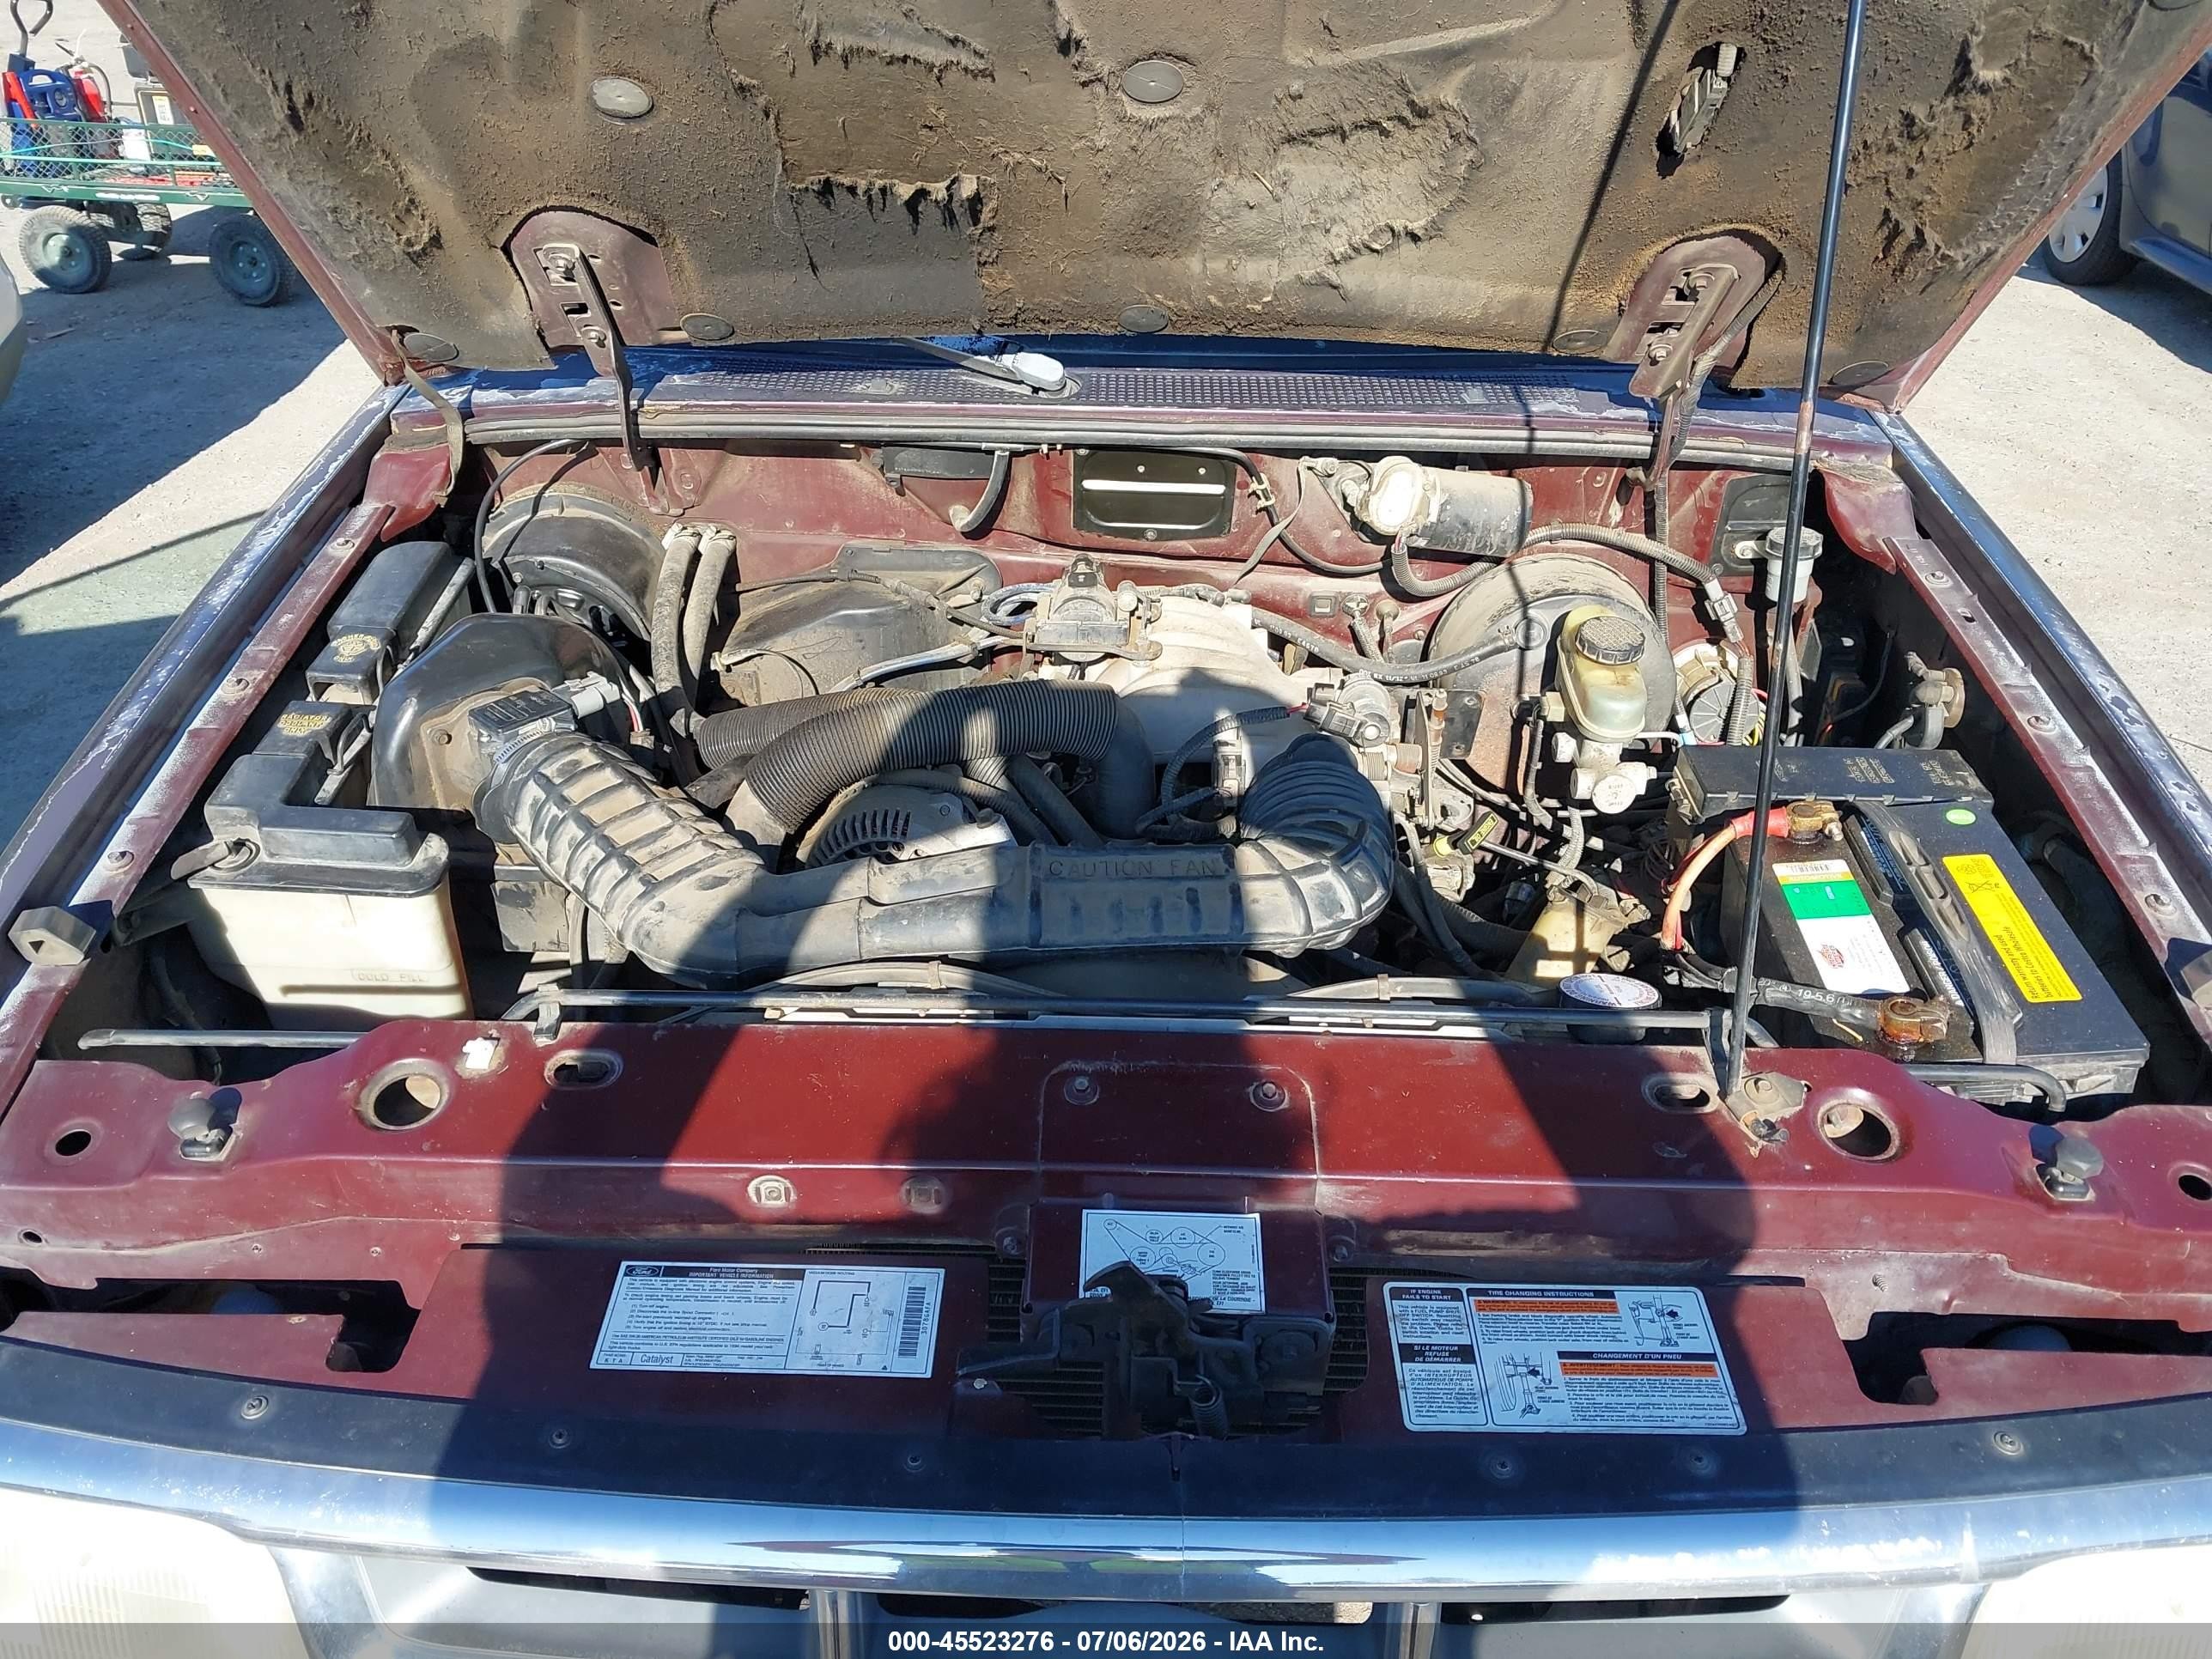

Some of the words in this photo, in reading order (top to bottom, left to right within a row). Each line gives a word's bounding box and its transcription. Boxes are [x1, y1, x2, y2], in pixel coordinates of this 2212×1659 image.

[1048, 860, 1152, 876] CAUTION
[1170, 860, 1217, 876] FAN
[641, 1354, 673, 1364] Catalyst
